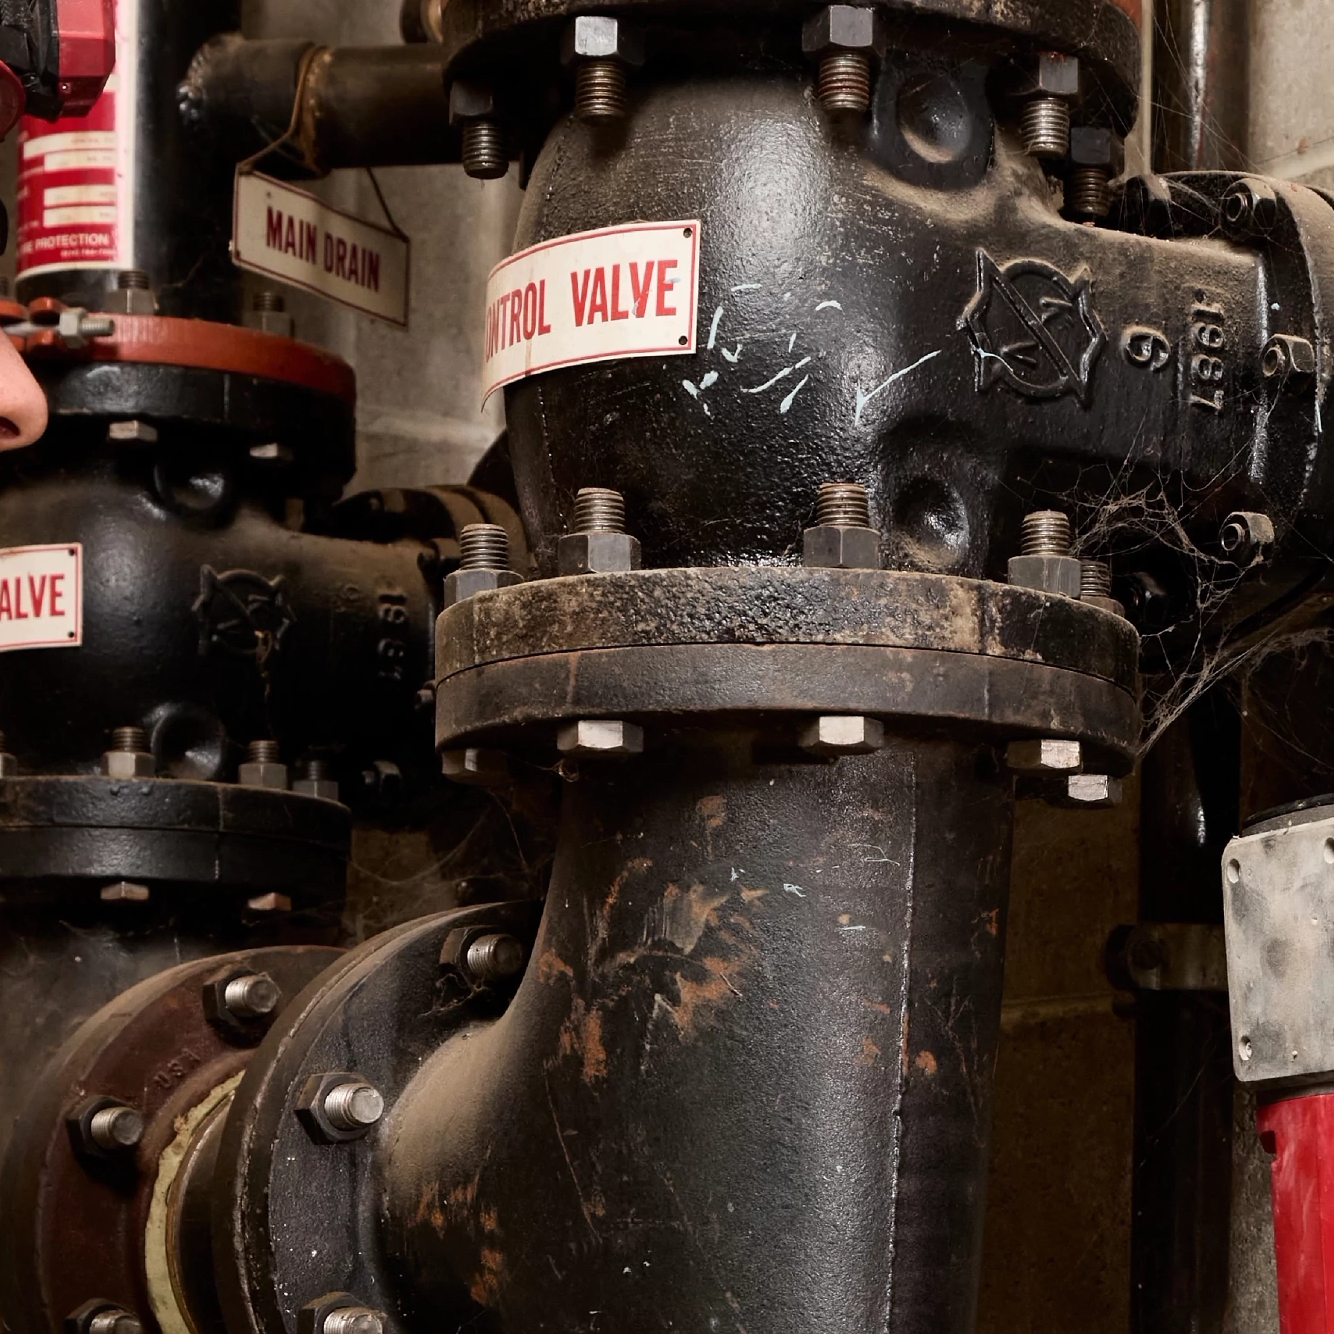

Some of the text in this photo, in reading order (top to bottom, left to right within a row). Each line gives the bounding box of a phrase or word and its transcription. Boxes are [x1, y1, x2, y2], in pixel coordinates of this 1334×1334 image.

[34, 232, 111, 250] PROTECTION
[265, 205, 381, 294] MAIN DRAIN
[569, 259, 679, 328] VALVE
